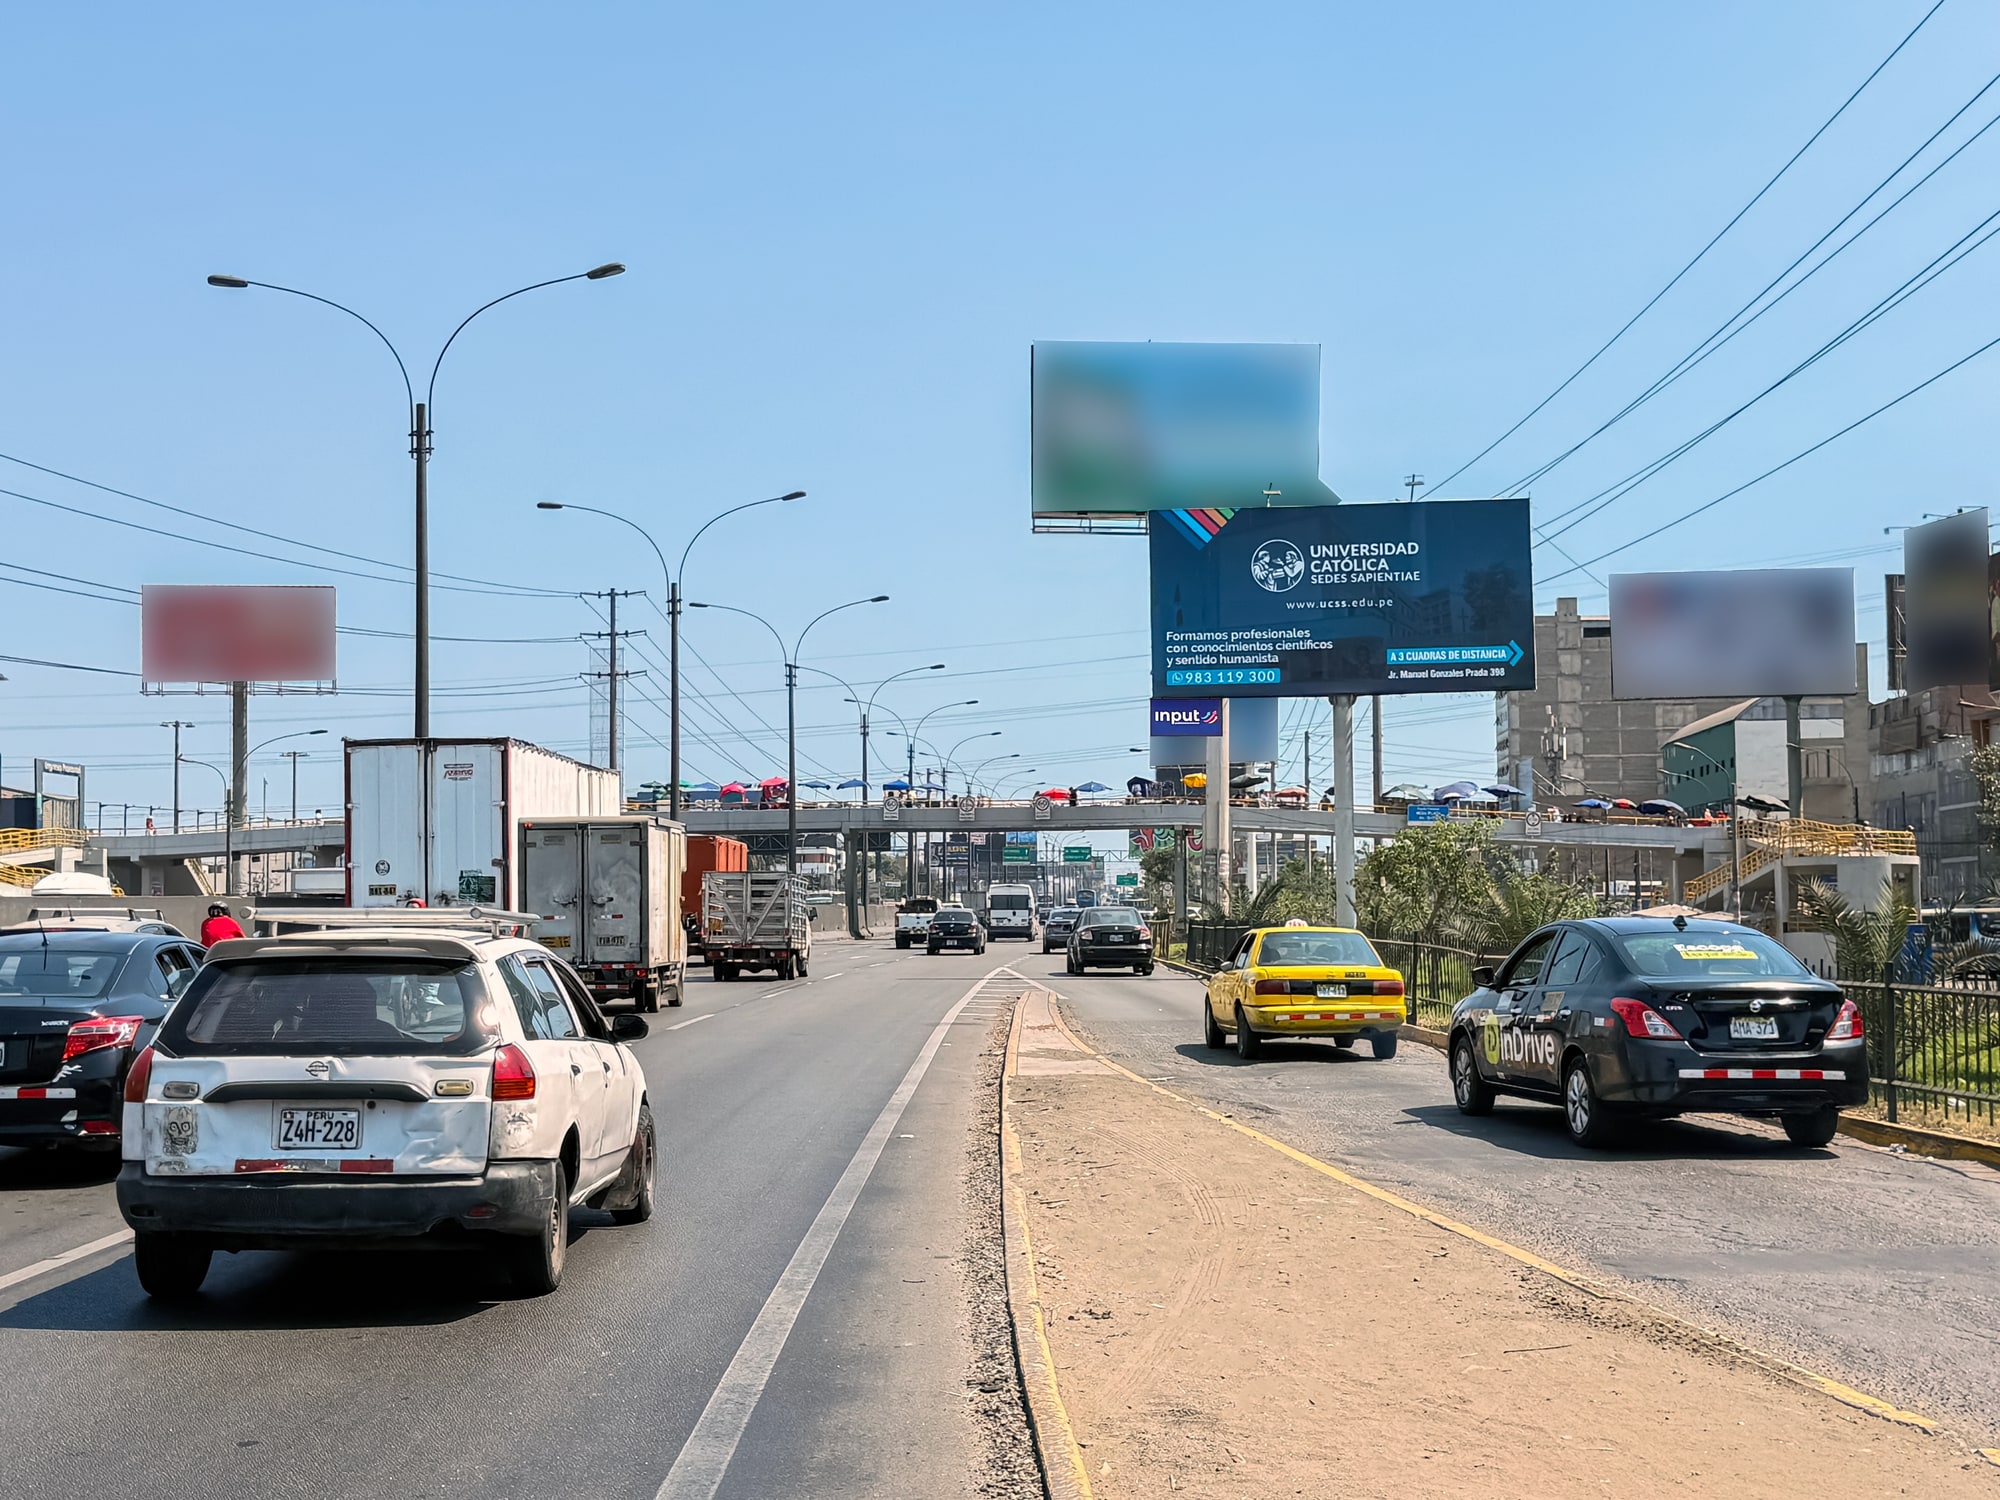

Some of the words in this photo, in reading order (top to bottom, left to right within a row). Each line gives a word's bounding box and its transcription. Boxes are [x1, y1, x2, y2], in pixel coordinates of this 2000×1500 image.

[1310, 542, 1419, 558] UNIVERSIDAD
[1310, 557, 1390, 573] CATÓLICA
[1310, 573, 1347, 584] SEDES
[1350, 571, 1421, 583] SAPIENTIAE
[1286, 598, 1393, 609] www.ucss.edu.pe
[1166, 631, 1229, 642] Formamos
[1231, 628, 1311, 642] profesionales
[1166, 643, 1188, 653] con
[1190, 641, 1274, 653] conocimientos
[1275, 639, 1334, 651] científicos
[1166, 656, 1174, 668] y
[1175, 654, 1218, 666] sentido
[1219, 652, 1280, 665] humanista
[1390, 653, 1397, 662] A
[1398, 652, 1404, 661] 3
[1405, 651, 1447, 661] CUADRAS
[1448, 650, 1459, 660] DE
[1461, 649, 1507, 660] DISTANCIA
[1185, 672, 1212, 683] 983
[1217, 672, 1244, 683] 119
[1249, 671, 1275, 682] 300
[1388, 670, 1399, 679] Jr.
[1400, 669, 1429, 679] Manuel
[1430, 668, 1465, 678] Gonzales
[1465, 667, 1488, 677] Prada
[1155, 710, 1200, 725] input
[1500, 1021, 1555, 1065] inDrive
[306, 1111, 335, 1120] PERU
[282, 1119, 355, 1142] Z4H-228
